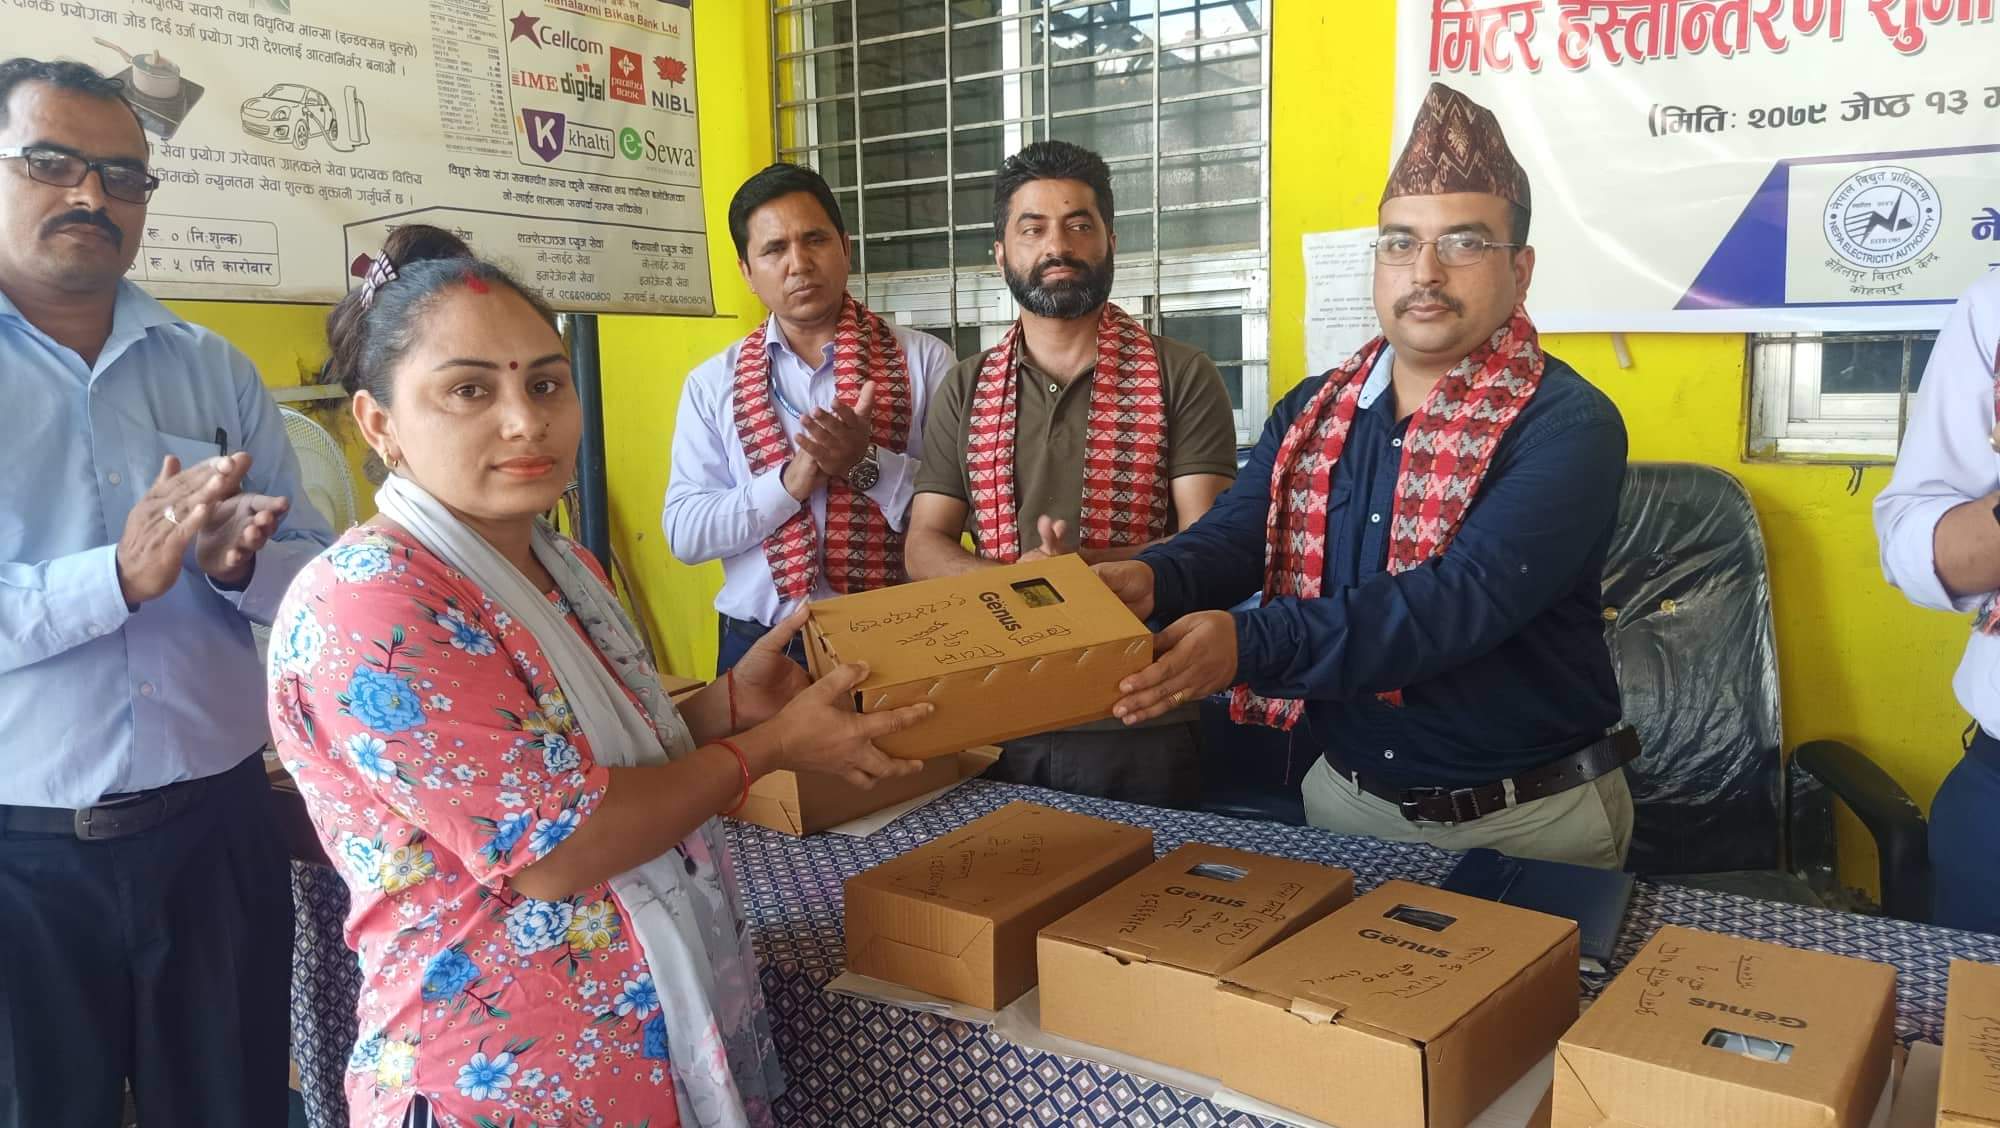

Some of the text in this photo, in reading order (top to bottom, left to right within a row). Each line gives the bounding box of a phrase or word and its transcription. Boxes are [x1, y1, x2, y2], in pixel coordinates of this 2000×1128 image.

[60, 3, 117, 24] प्रयोगमा
[123, 10, 147, 29] जोड
[199, 28, 232, 46] प्रयोग
[237, 35, 259, 51] गरी
[228, 11, 249, 25] तथा
[604, 7, 635, 22] Bikas
[637, 14, 658, 30] Bank
[540, 25, 604, 56] Cellcom
[1429, 0, 1544, 74] मिटर
[652, 90, 694, 114] NIBL
[1747, 103, 1828, 130] २०७९
[1924, 89, 1969, 115] १३
[534, 116, 610, 153] K khalti
[160, 141, 185, 159] सेवा
[190, 146, 225, 163] प्रयोग
[325, 161, 346, 176] सेवा
[259, 176, 281, 192] सेवा
[1842, 242, 1895, 264] ELECTRICITY
[1896, 215, 1935, 259] AUTHORITY
[978, 591, 1022, 632] Genus
[1164, 886, 1248, 909] Genus
[1358, 928, 1452, 959] Genus
[1688, 996, 1808, 1030] Genus
